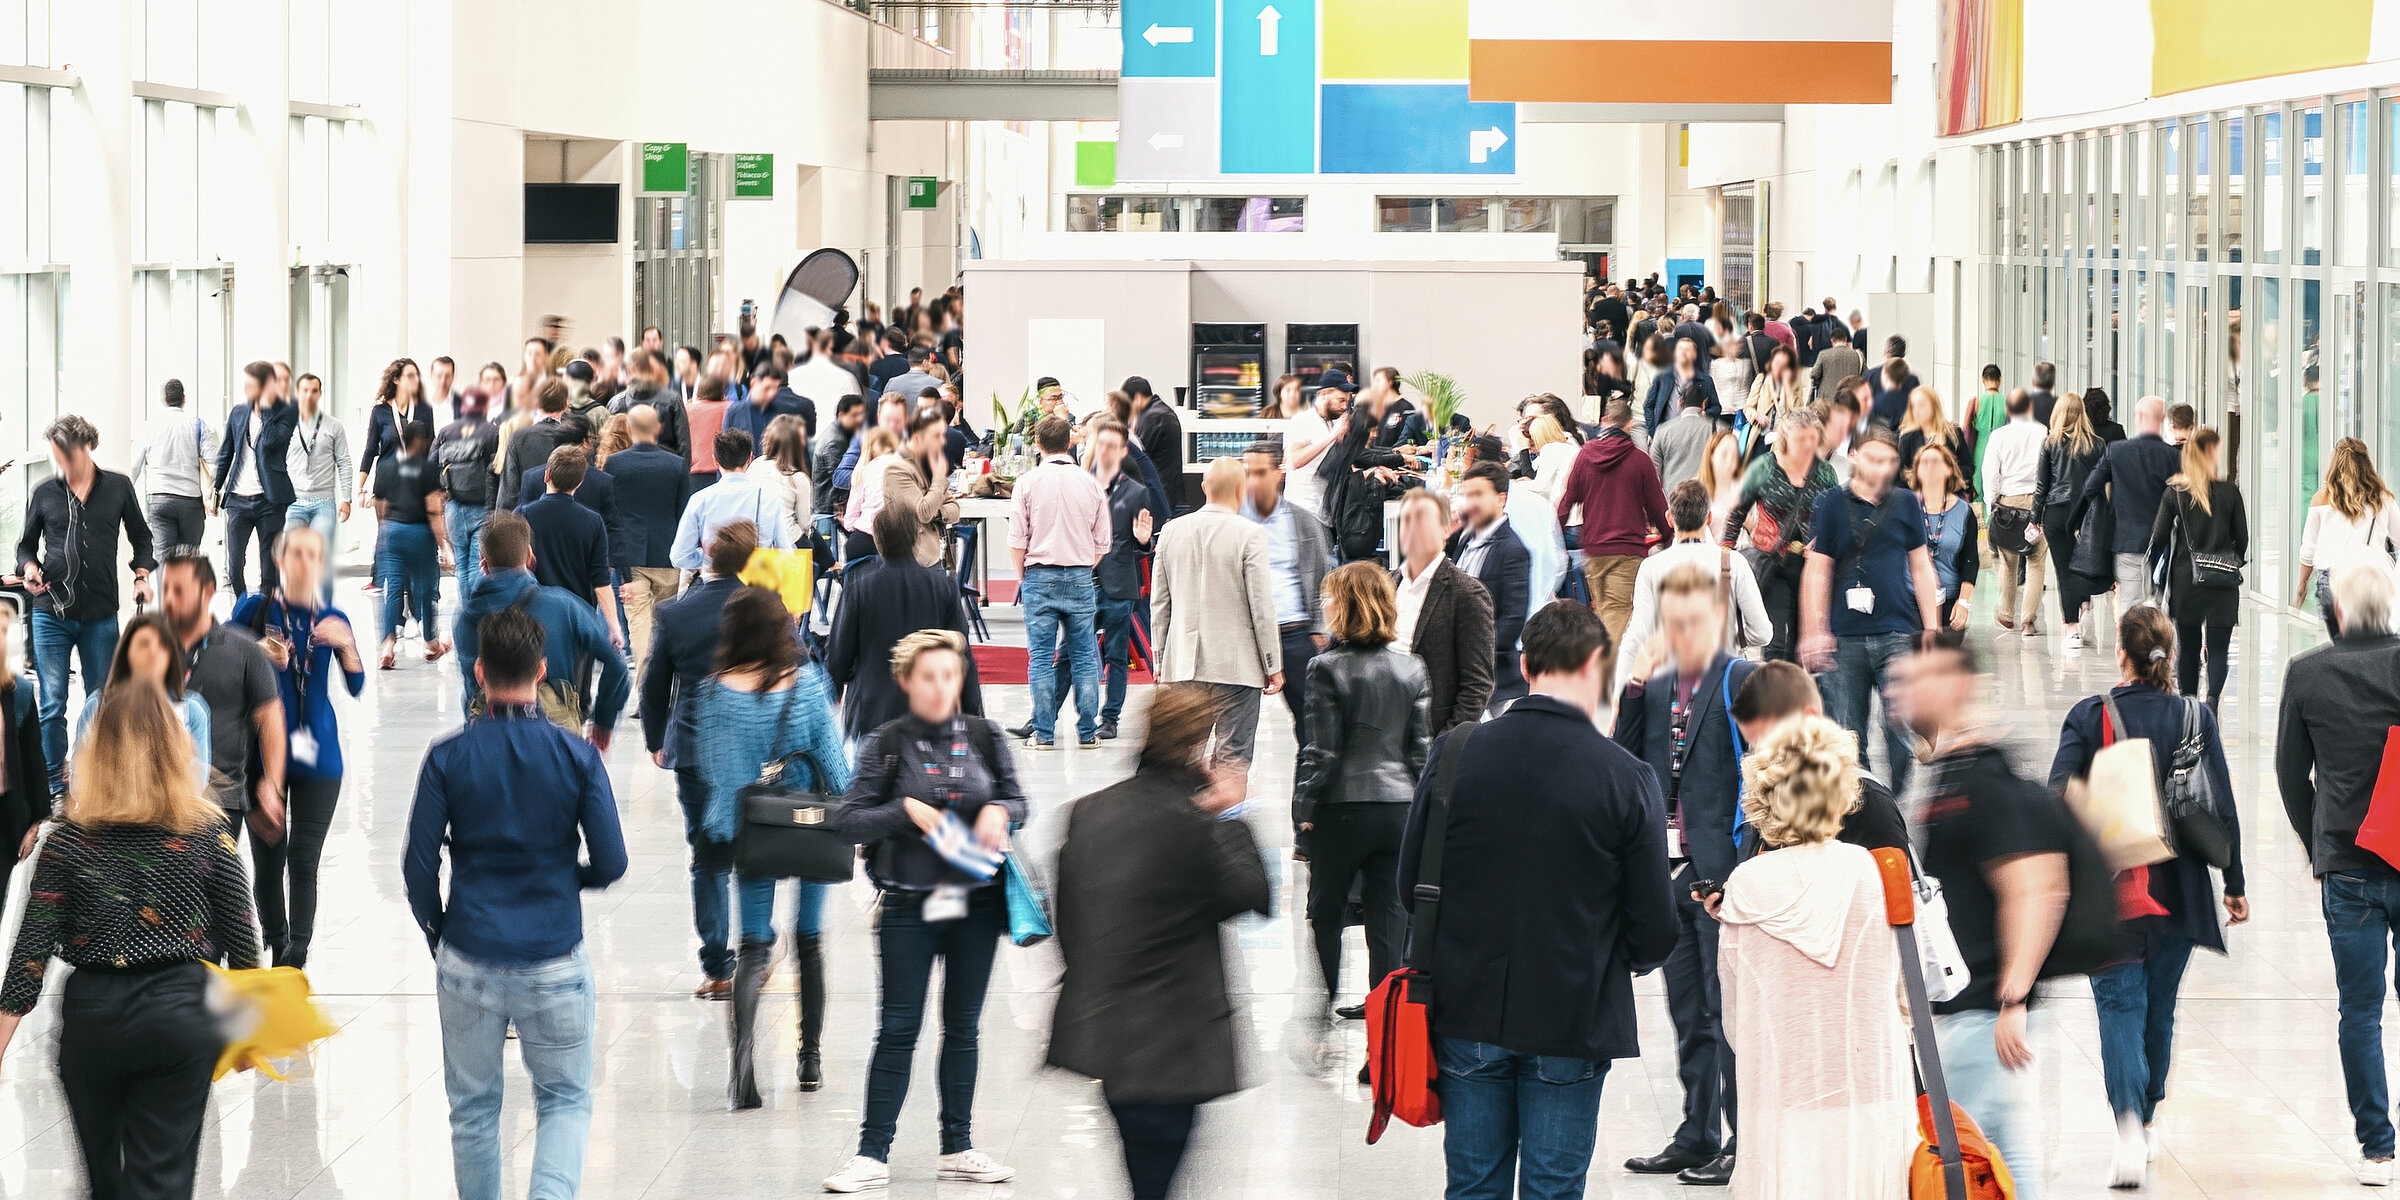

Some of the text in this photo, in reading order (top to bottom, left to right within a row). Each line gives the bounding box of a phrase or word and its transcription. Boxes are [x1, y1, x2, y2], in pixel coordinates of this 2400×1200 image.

[644, 144, 672, 153] Copy &
[644, 153, 664, 162] Shop
